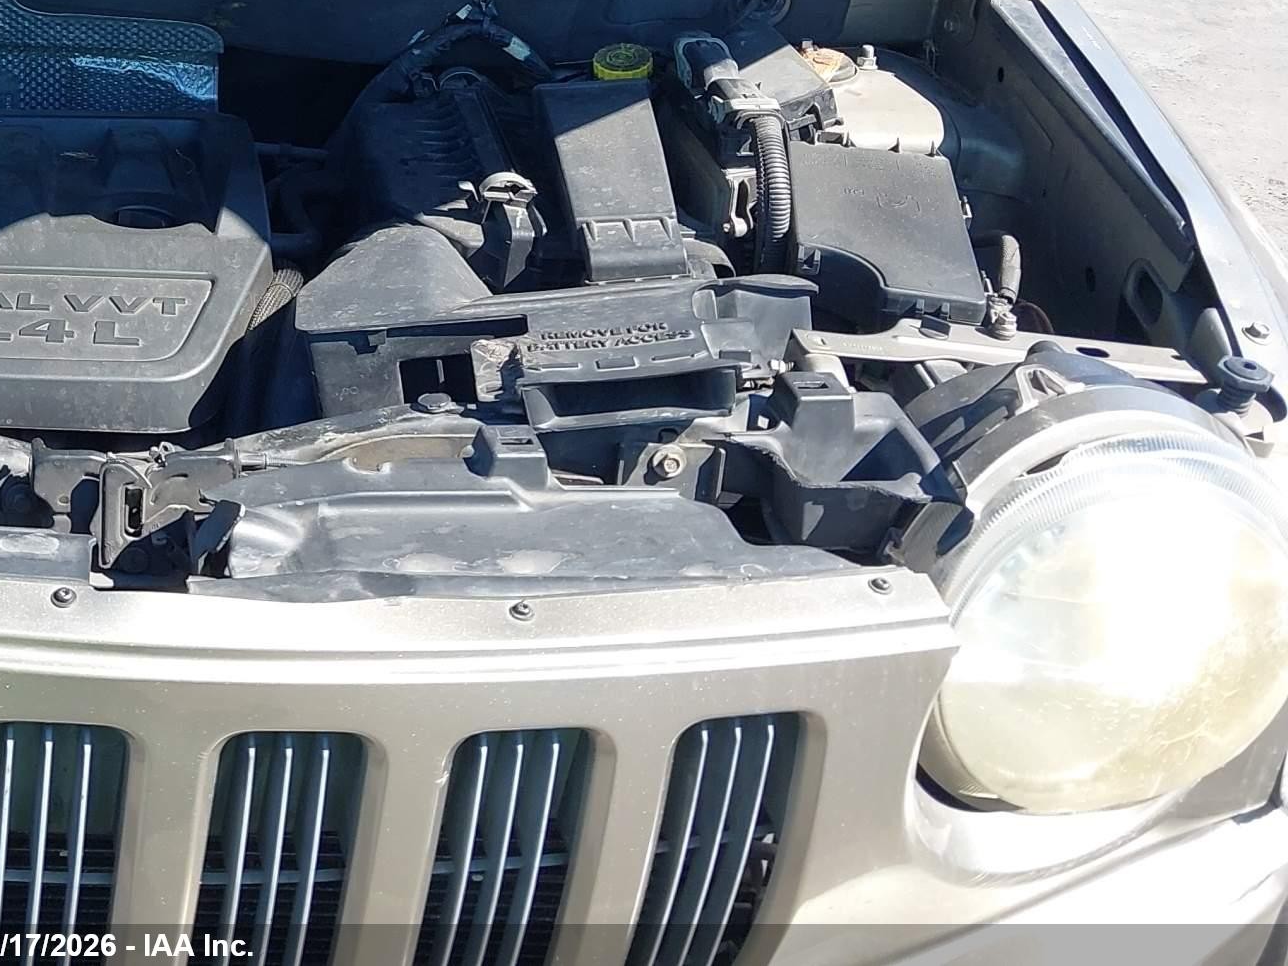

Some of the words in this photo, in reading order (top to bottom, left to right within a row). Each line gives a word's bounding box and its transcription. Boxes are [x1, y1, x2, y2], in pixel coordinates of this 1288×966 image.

[64, 294, 187, 315] VVT
[527, 338, 609, 352] BATTERY
[614, 329, 695, 346] ACCESS
[540, 327, 622, 341] REMOVE
[626, 322, 668, 335] FOR
